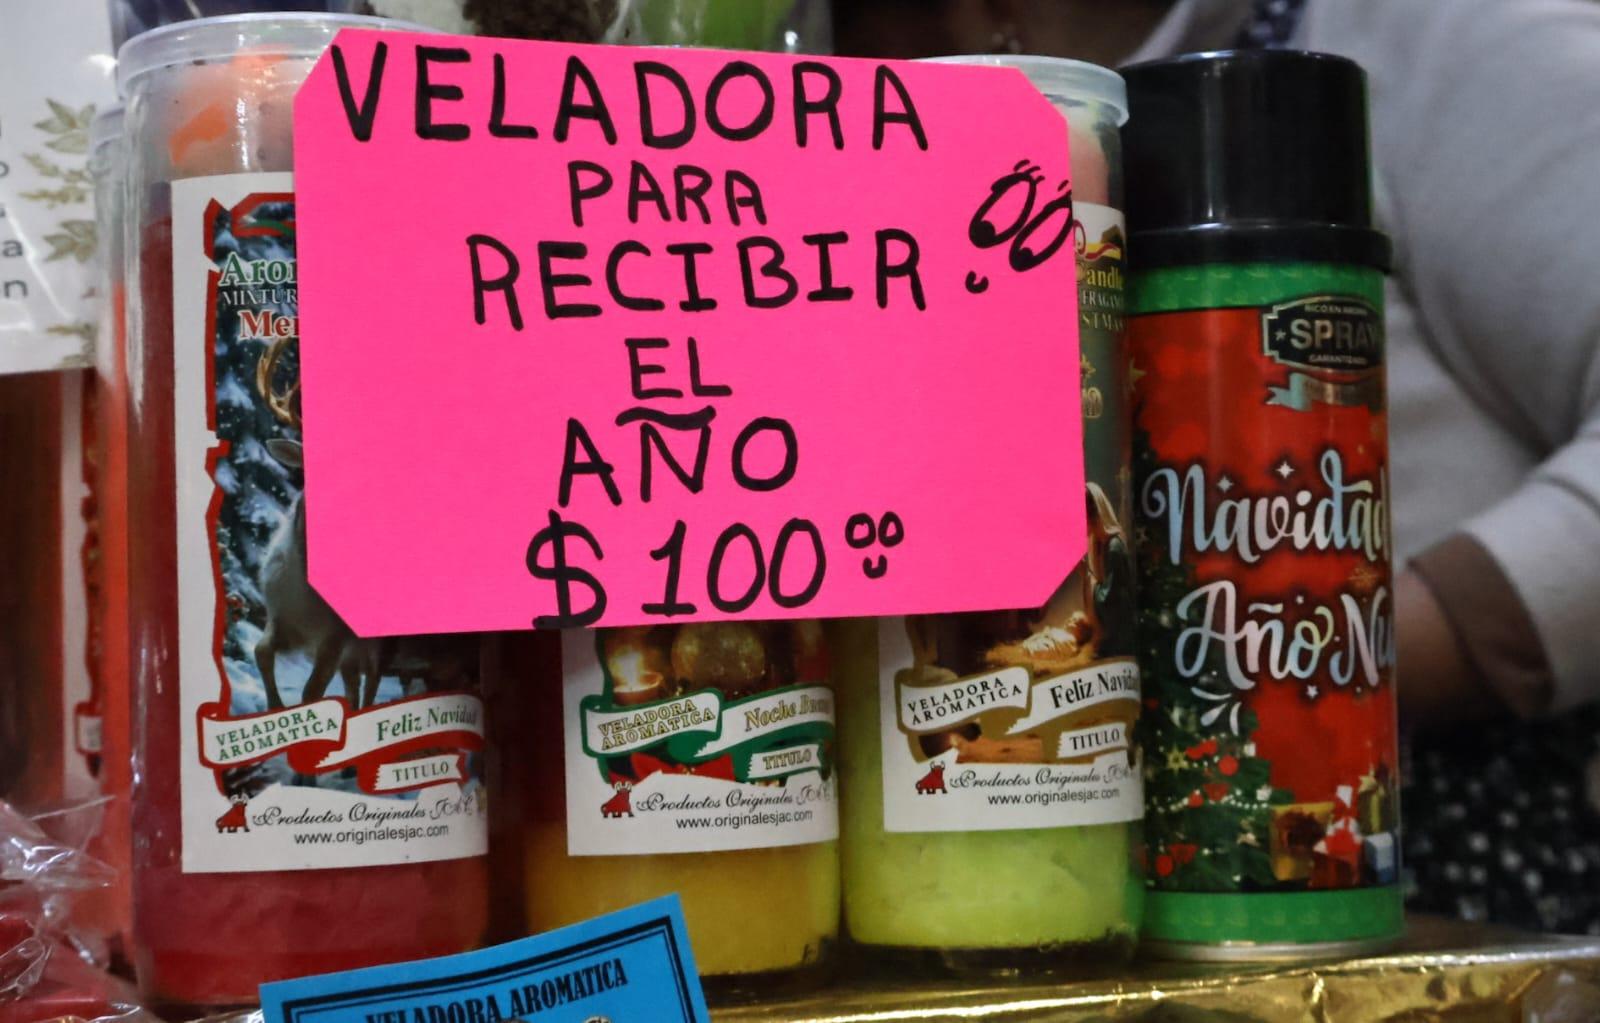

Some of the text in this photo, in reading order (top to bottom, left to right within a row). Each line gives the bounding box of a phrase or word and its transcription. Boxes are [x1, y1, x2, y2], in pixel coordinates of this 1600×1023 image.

[331, 42, 928, 150] VELADORA
[567, 160, 768, 227] PARA
[465, 228, 927, 332] RECIBIR
[1290, 318, 1378, 350] SPRAY
[624, 336, 733, 399] EL
[558, 405, 798, 506] AÑO
[1174, 579, 1335, 690] Año
[907, 676, 1004, 713] VELADORA
[911, 684, 1023, 726] AROMATICA
[1049, 678, 1095, 709] Feliz
[215, 708, 318, 747] VELADORA
[376, 712, 423, 742] Feliz
[598, 699, 698, 737] VELADORA
[601, 708, 716, 751] AROMATICA
[744, 698, 797, 732] Noche
[218, 718, 338, 762] AROMATICA
[1069, 728, 1121, 751] TITULO
[391, 761, 450, 783] TITULO
[762, 749, 812, 770] TITULO
[950, 769, 1031, 789] Productos
[1035, 766, 1101, 791] Originales
[253, 806, 343, 827] Productos
[348, 801, 426, 828] Originales
[636, 792, 721, 812] Productos
[725, 787, 793, 814] Originales
[987, 787, 1121, 807] www.originalesjac.com
[294, 822, 450, 845] www.originalesjac.com
[675, 809, 813, 830] www.originalesjac.com
[510, 957, 629, 1020] AROMATICA
